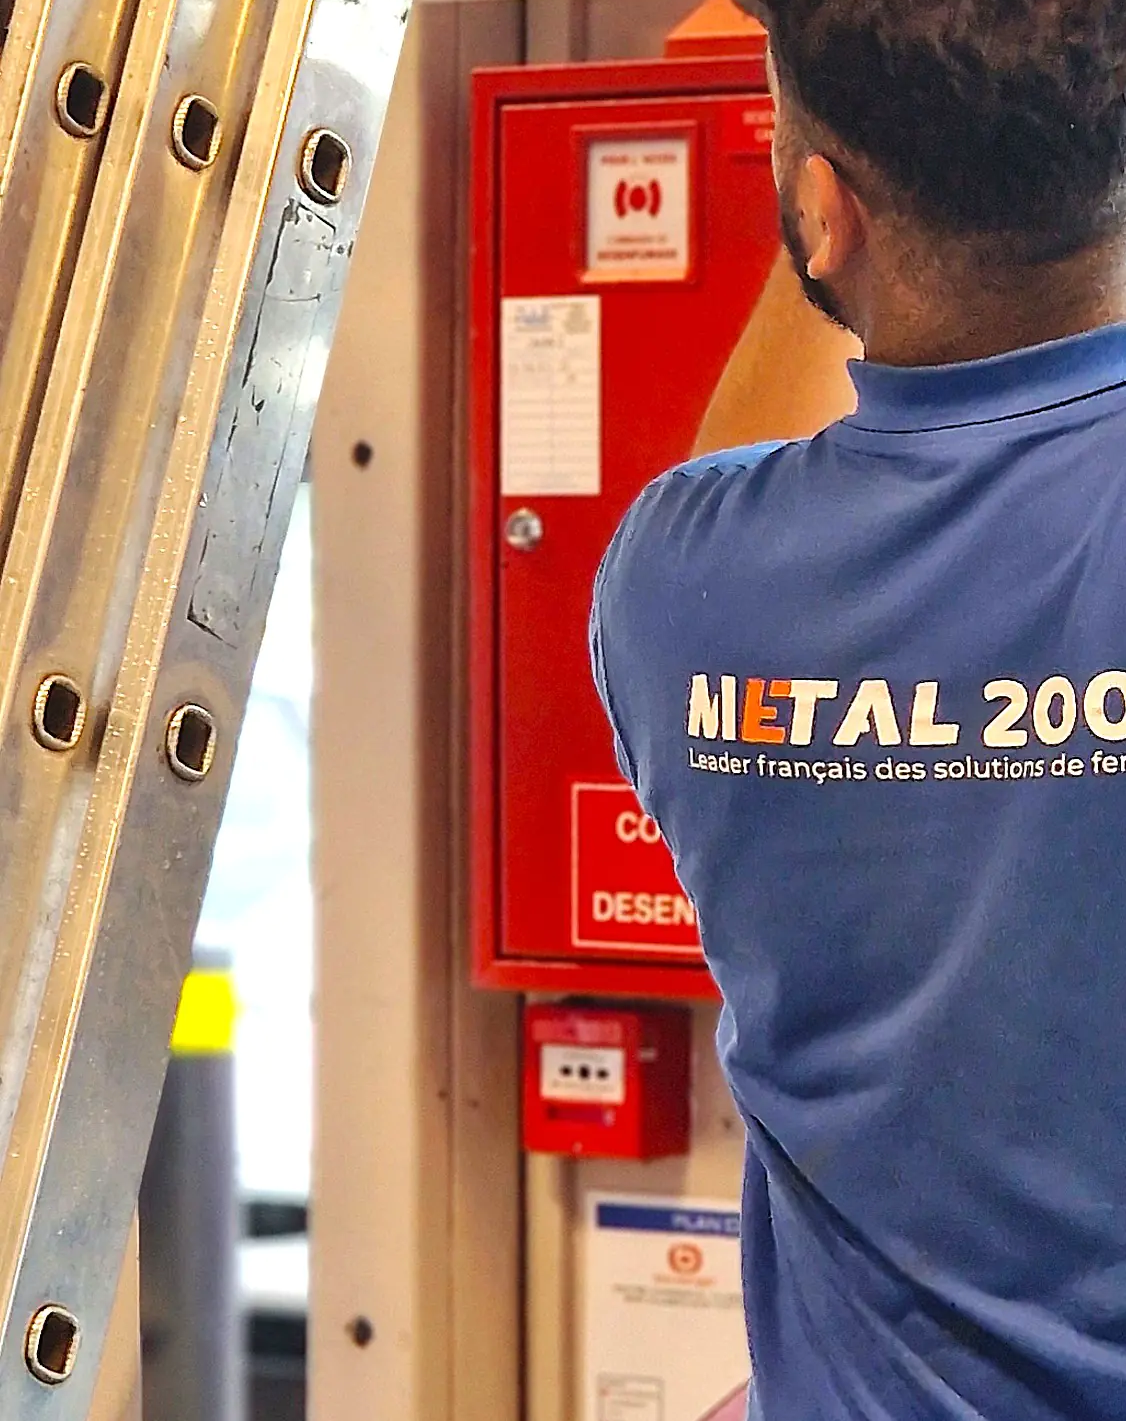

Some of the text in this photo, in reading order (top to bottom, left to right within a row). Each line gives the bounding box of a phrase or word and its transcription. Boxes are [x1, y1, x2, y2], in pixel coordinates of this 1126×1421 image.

[687, 673, 960, 747] METAL
[688, 747, 751, 776] Leader
[756, 753, 867, 785] français
[875, 757, 927, 781] des
[933, 754, 1045, 781] solutions
[1050, 752, 1085, 777] de
